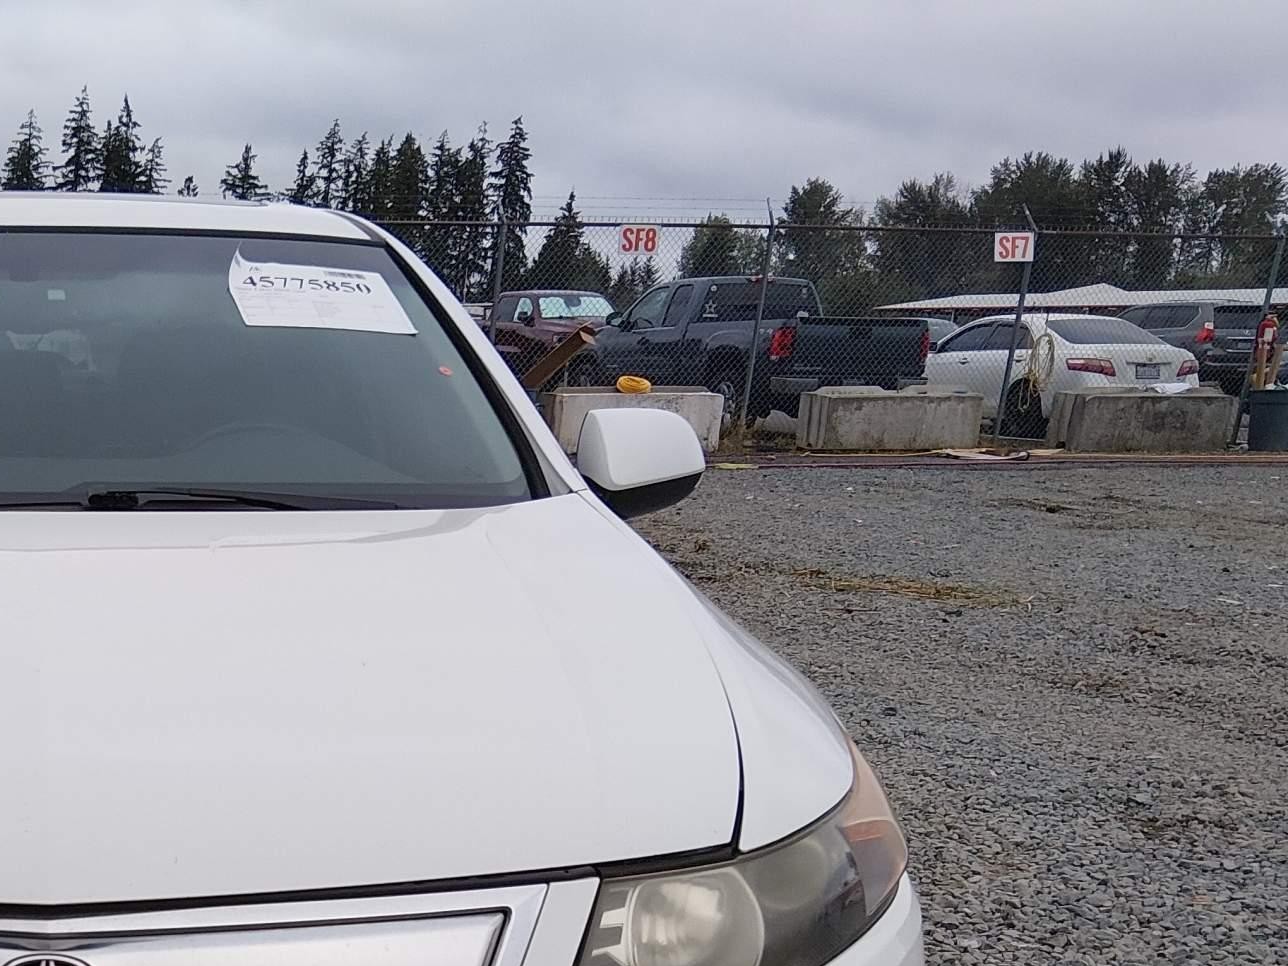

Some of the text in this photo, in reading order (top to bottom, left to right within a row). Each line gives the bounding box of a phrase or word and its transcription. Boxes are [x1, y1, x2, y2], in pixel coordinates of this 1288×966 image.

[622, 228, 657, 252] SF8
[998, 236, 1030, 259] SF7
[242, 275, 373, 295] 45775850
